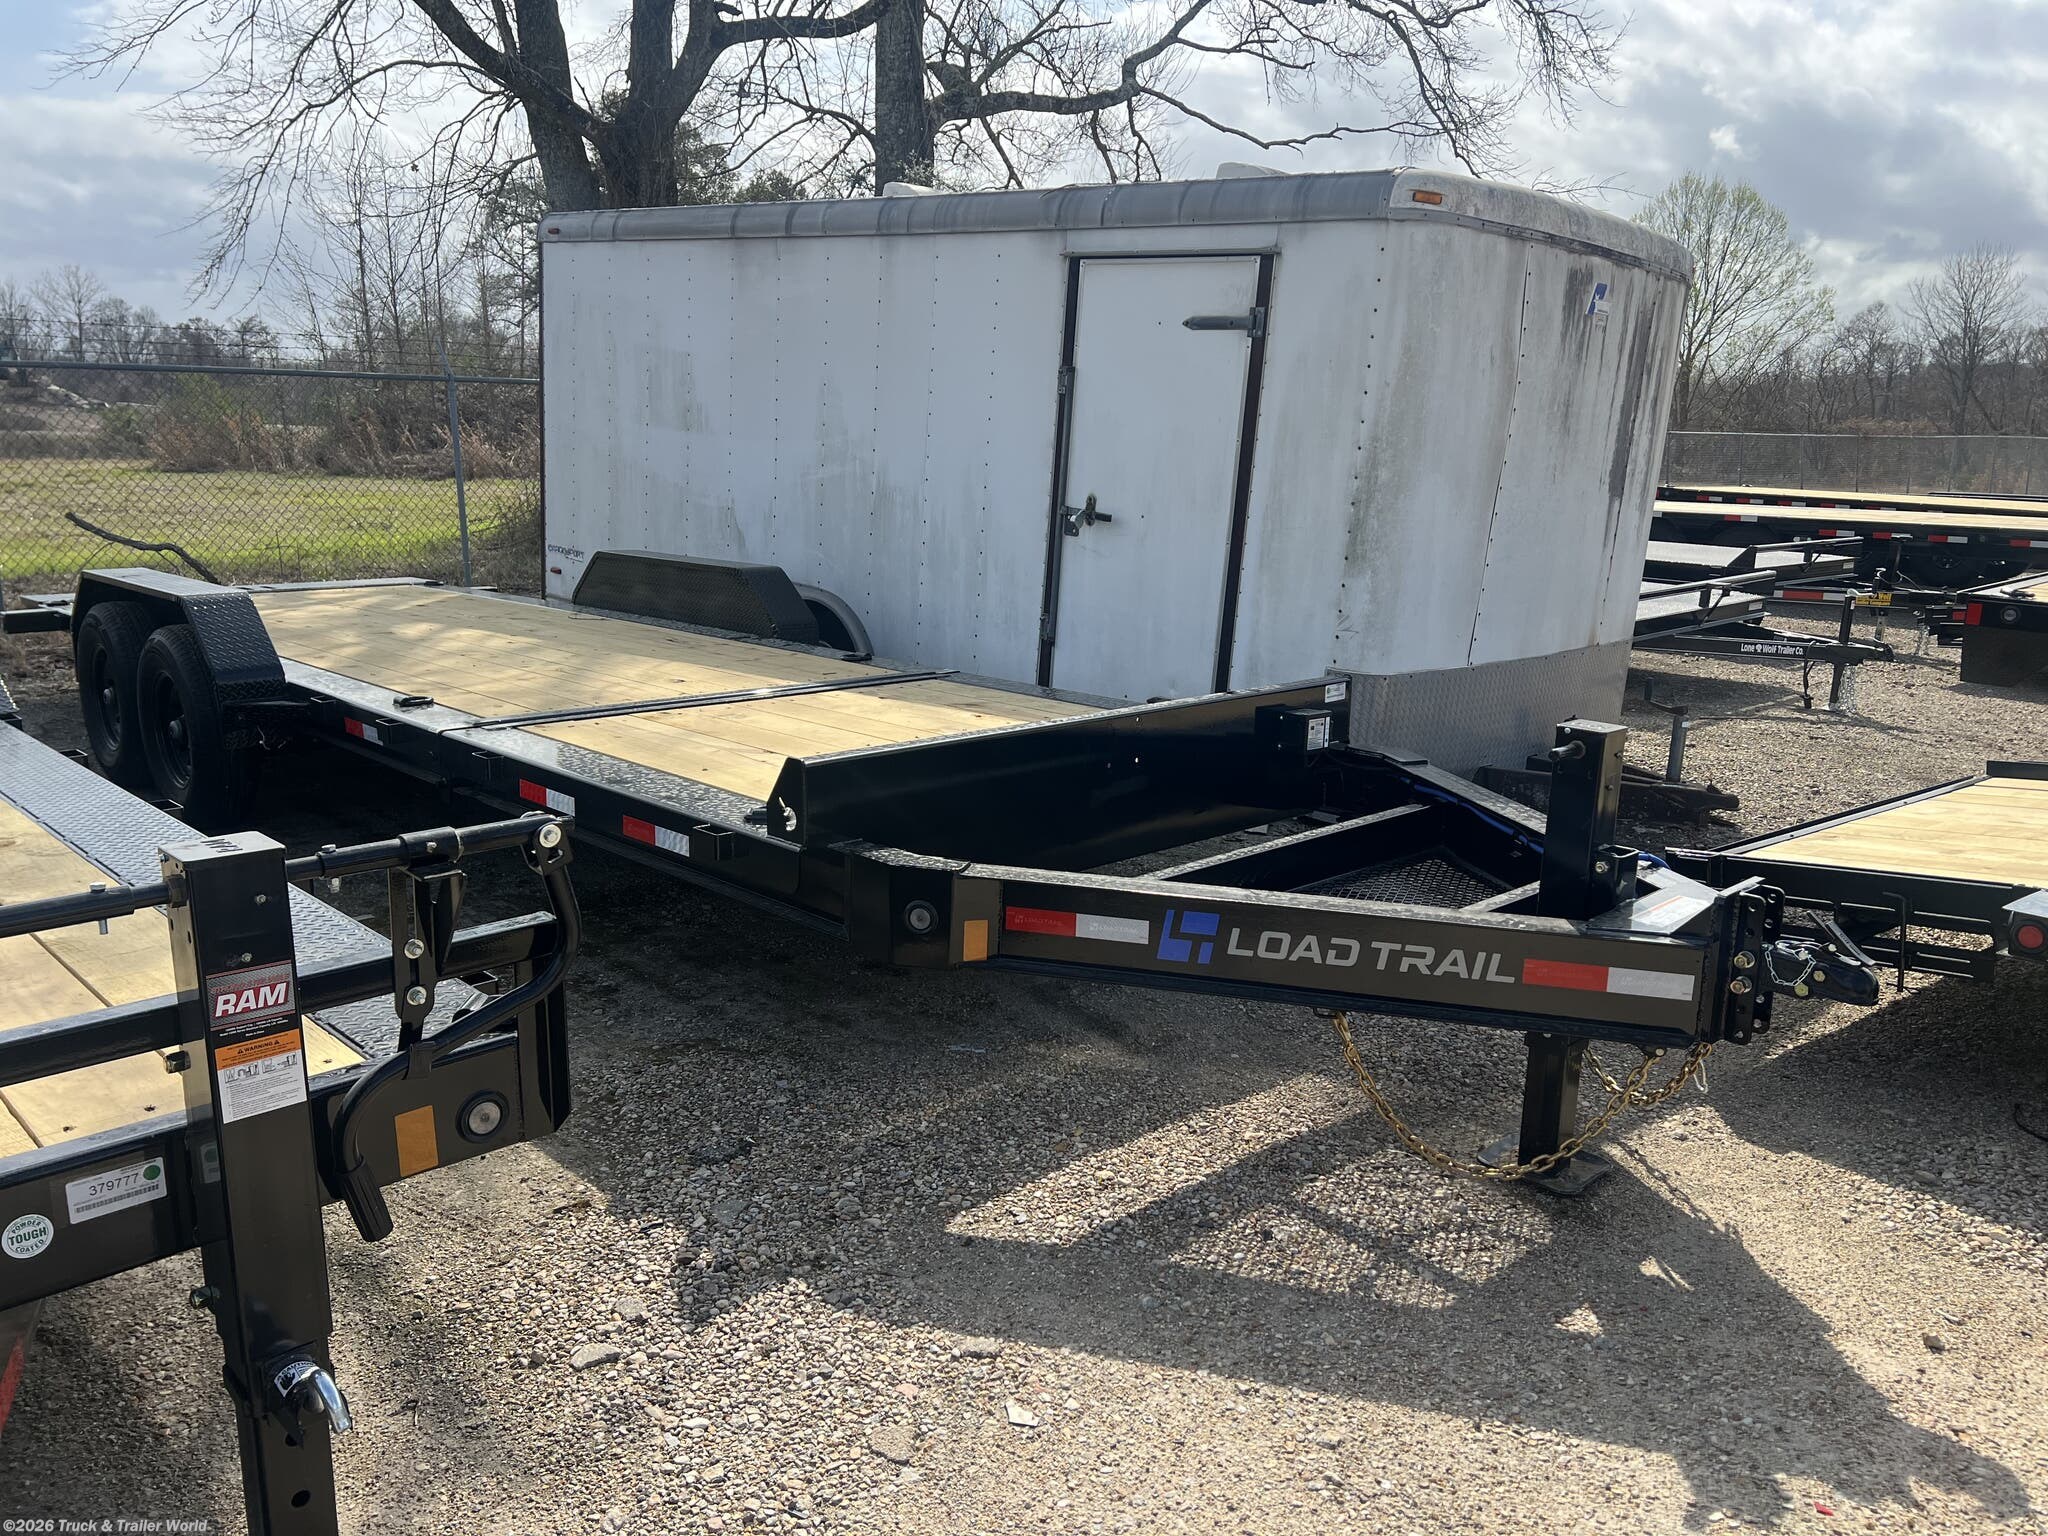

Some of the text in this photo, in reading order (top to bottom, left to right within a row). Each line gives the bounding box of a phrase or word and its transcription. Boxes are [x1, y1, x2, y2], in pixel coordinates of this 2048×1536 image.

[1741, 643, 1755, 653] Lone
[1763, 644, 1777, 654] Wolf
[1778, 645, 1796, 655] Trailer
[1226, 927, 1361, 967] LOAD
[1371, 941, 1516, 984] TRAIL
[214, 982, 288, 1018] RAM
[243, 1042, 273, 1053] WARNING
[88, 1172, 140, 1197] 379777
[11, 1219, 42, 1234] POWDER
[8, 1226, 47, 1246] TOUGH
[15, 1239, 44, 1253] COATED
